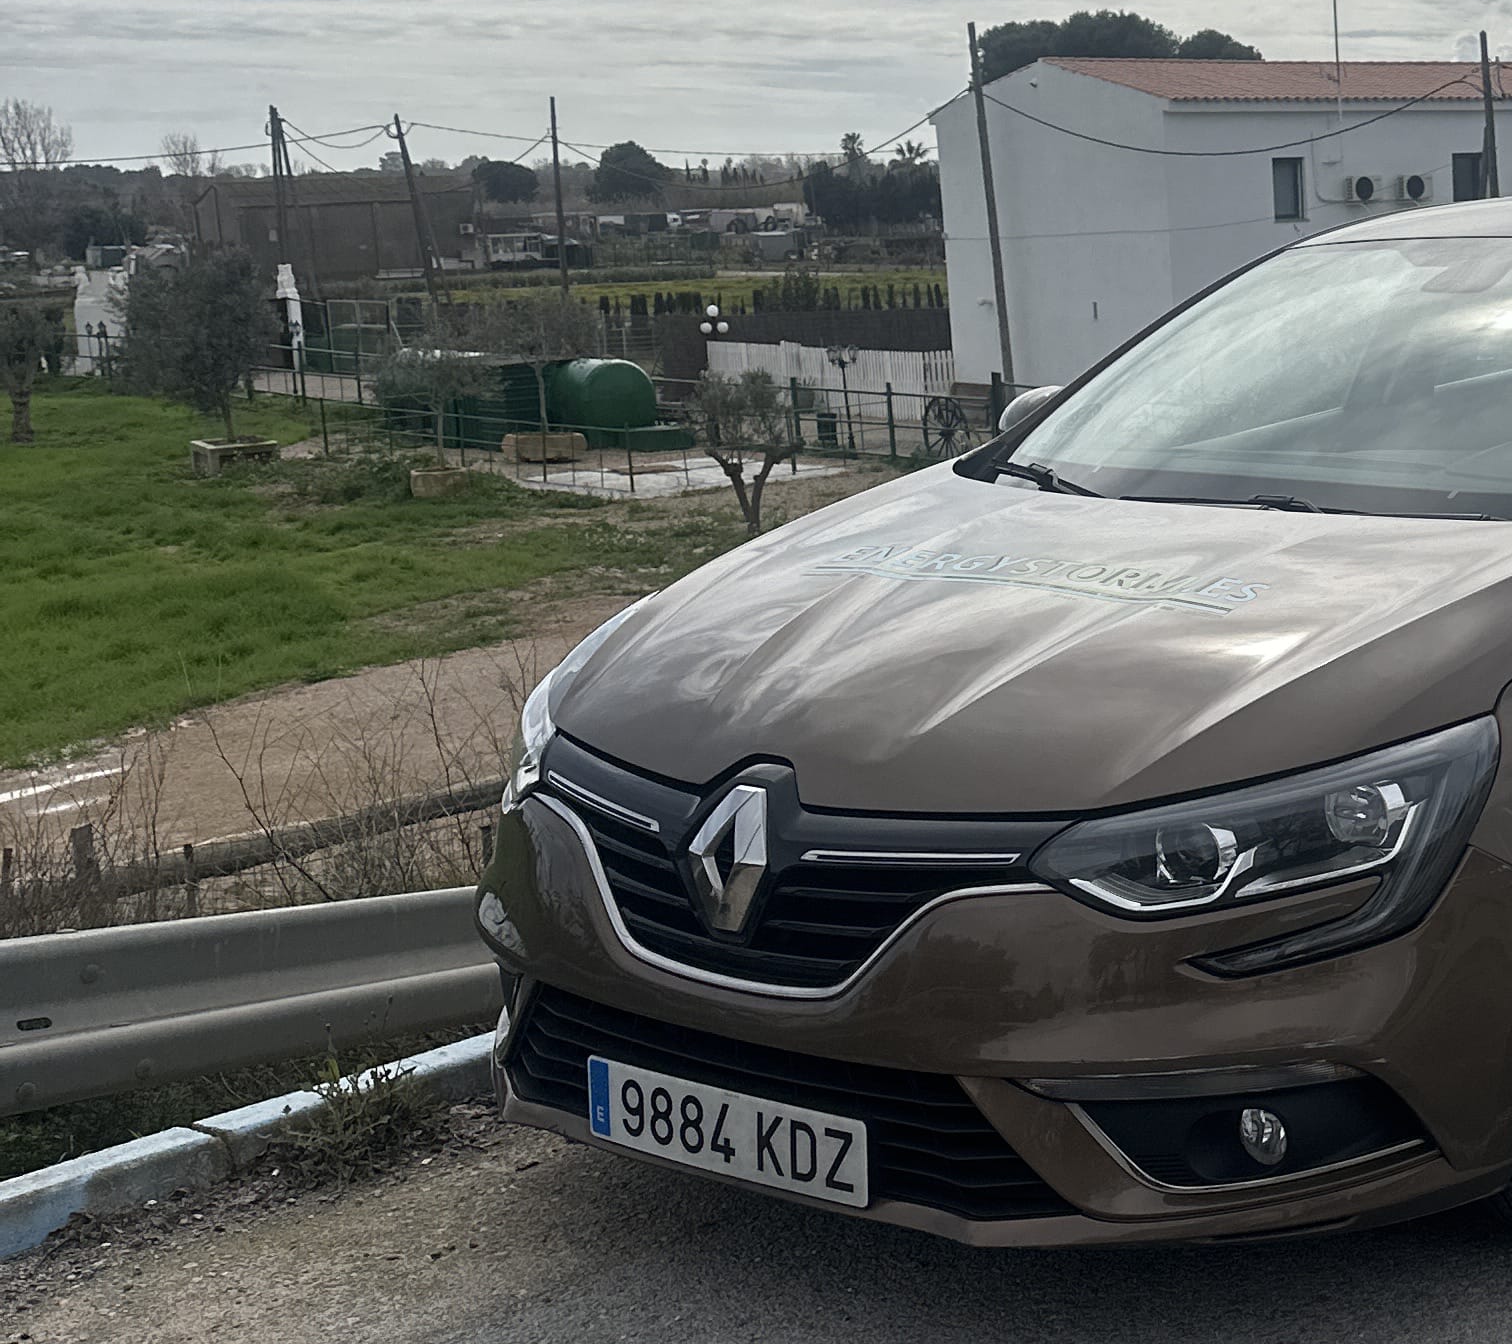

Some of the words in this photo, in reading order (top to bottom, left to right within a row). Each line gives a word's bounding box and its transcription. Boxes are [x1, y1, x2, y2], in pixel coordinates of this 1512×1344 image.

[597, 1104, 605, 1123] E
[621, 1079, 736, 1163] 9884
[756, 1111, 854, 1193] KDZ
